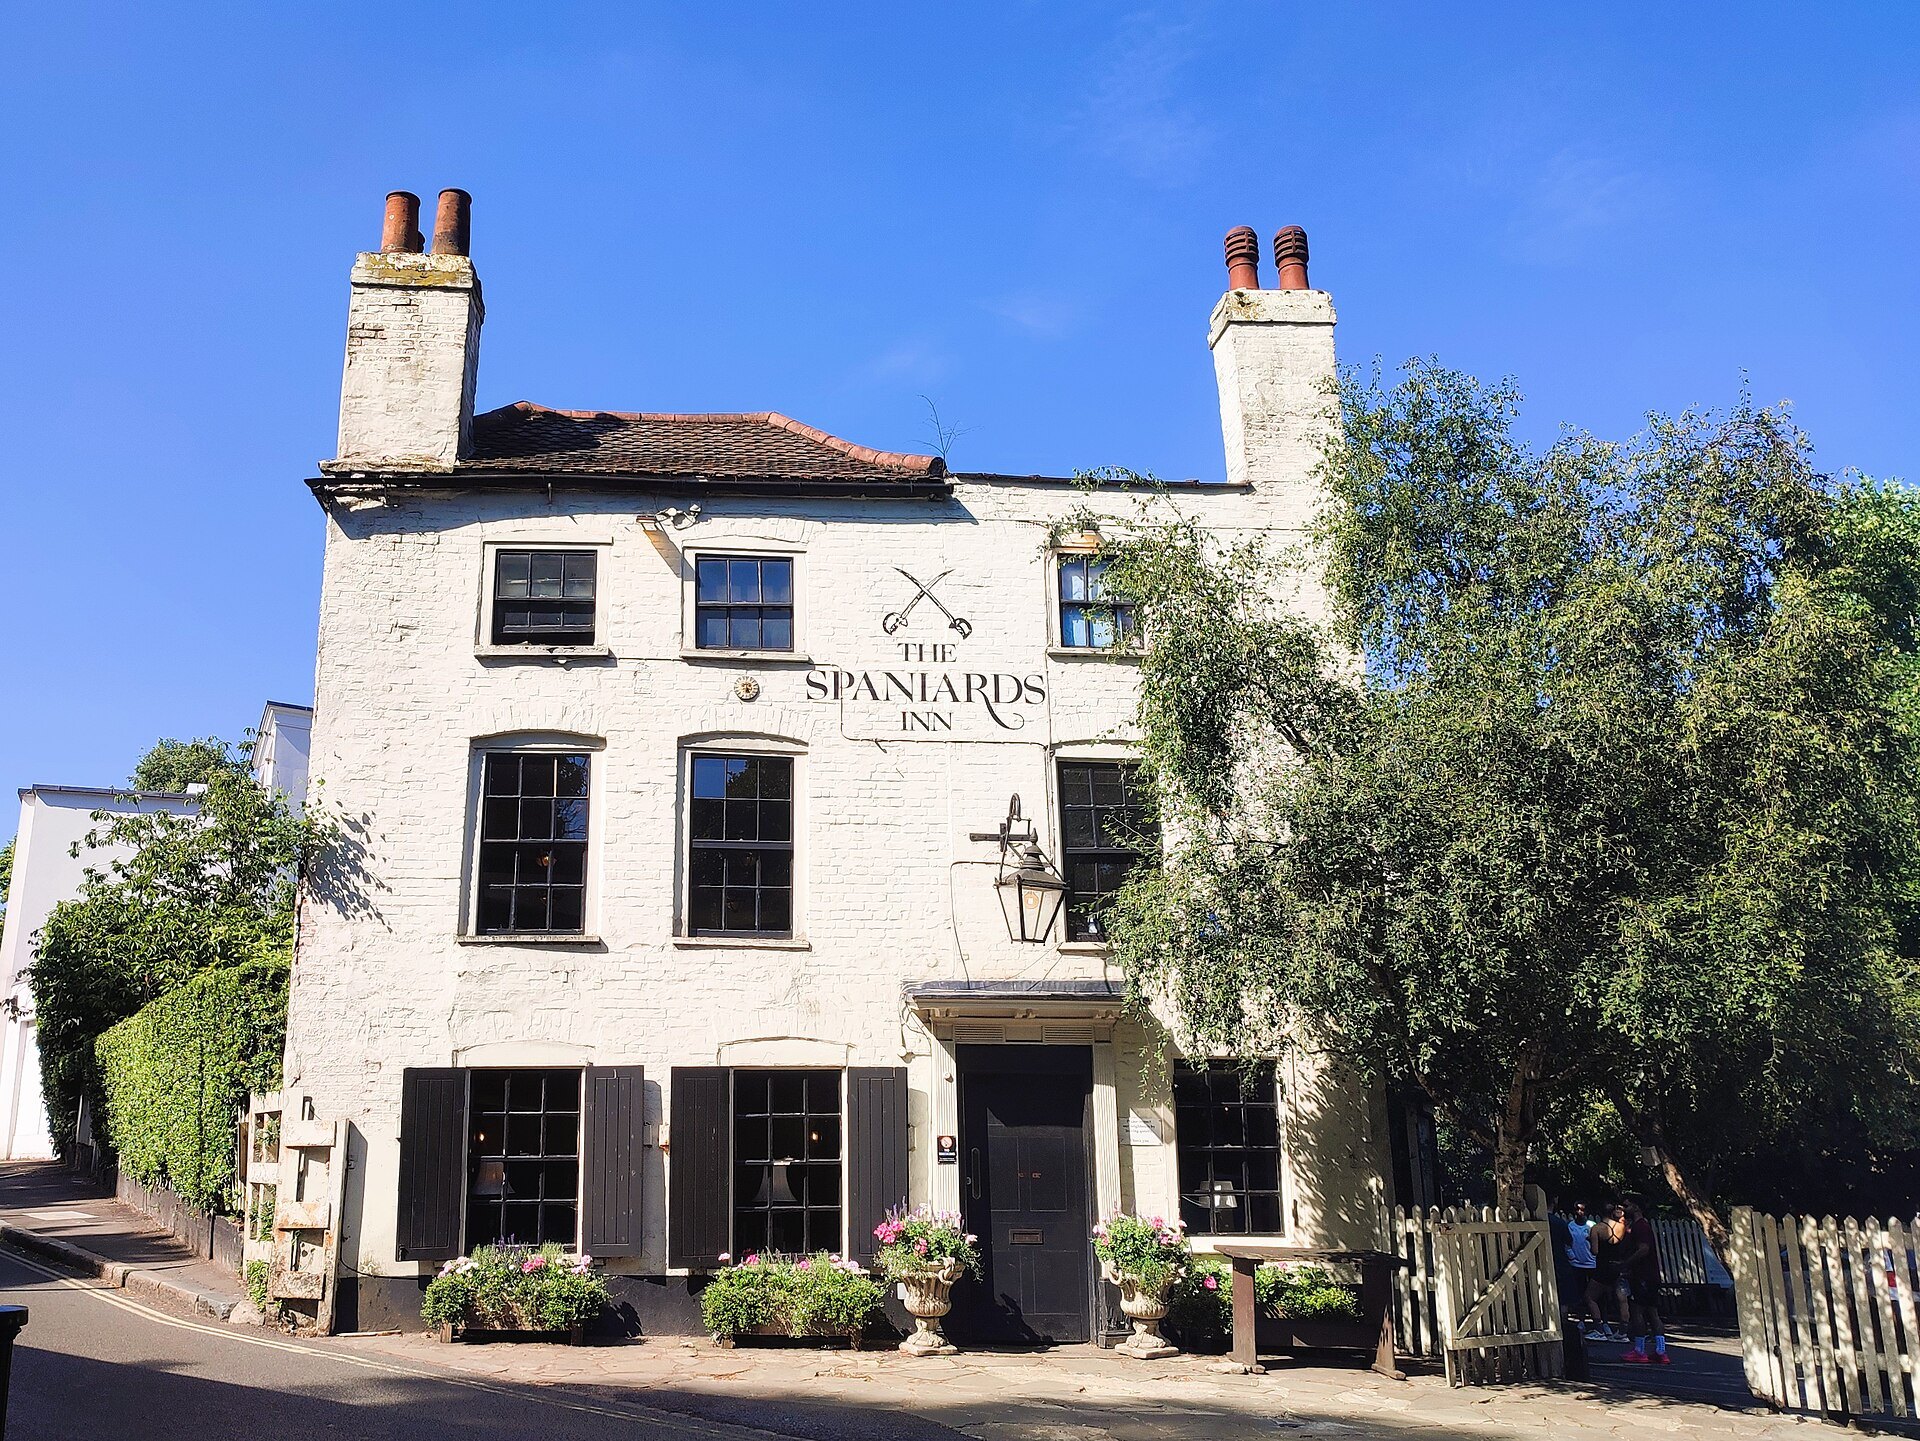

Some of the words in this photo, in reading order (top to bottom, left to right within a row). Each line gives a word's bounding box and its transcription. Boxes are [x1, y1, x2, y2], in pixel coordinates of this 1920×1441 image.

[898, 642, 957, 663] THE
[805, 670, 1046, 730] SPANIARDS
[900, 711, 953, 732] INN
